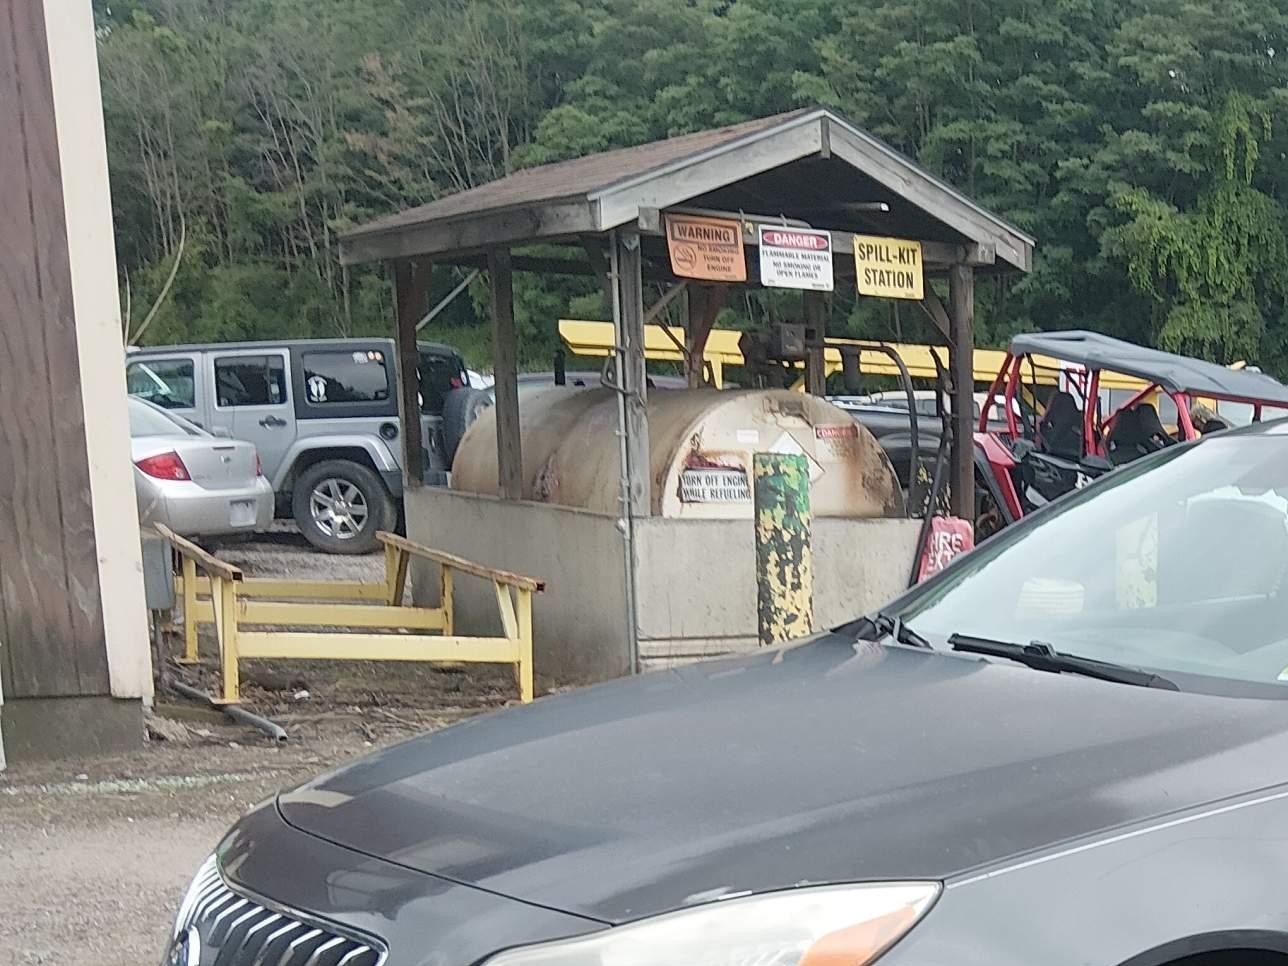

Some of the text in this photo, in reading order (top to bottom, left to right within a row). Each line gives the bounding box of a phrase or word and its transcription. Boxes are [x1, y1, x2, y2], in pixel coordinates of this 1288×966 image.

[677, 225, 731, 242] WARNING
[773, 232, 818, 249] DANGER
[762, 249, 830, 262] FLAMMABLE MATERIAL
[858, 242, 918, 266] SPILL-KIT
[706, 264, 731, 273] ENGINE
[783, 262, 811, 271] SMOKING
[864, 266, 914, 289] STATION
[682, 475, 702, 486] TURN
[705, 475, 718, 486] OFF
[682, 487, 752, 500] WHILE REFUELING
